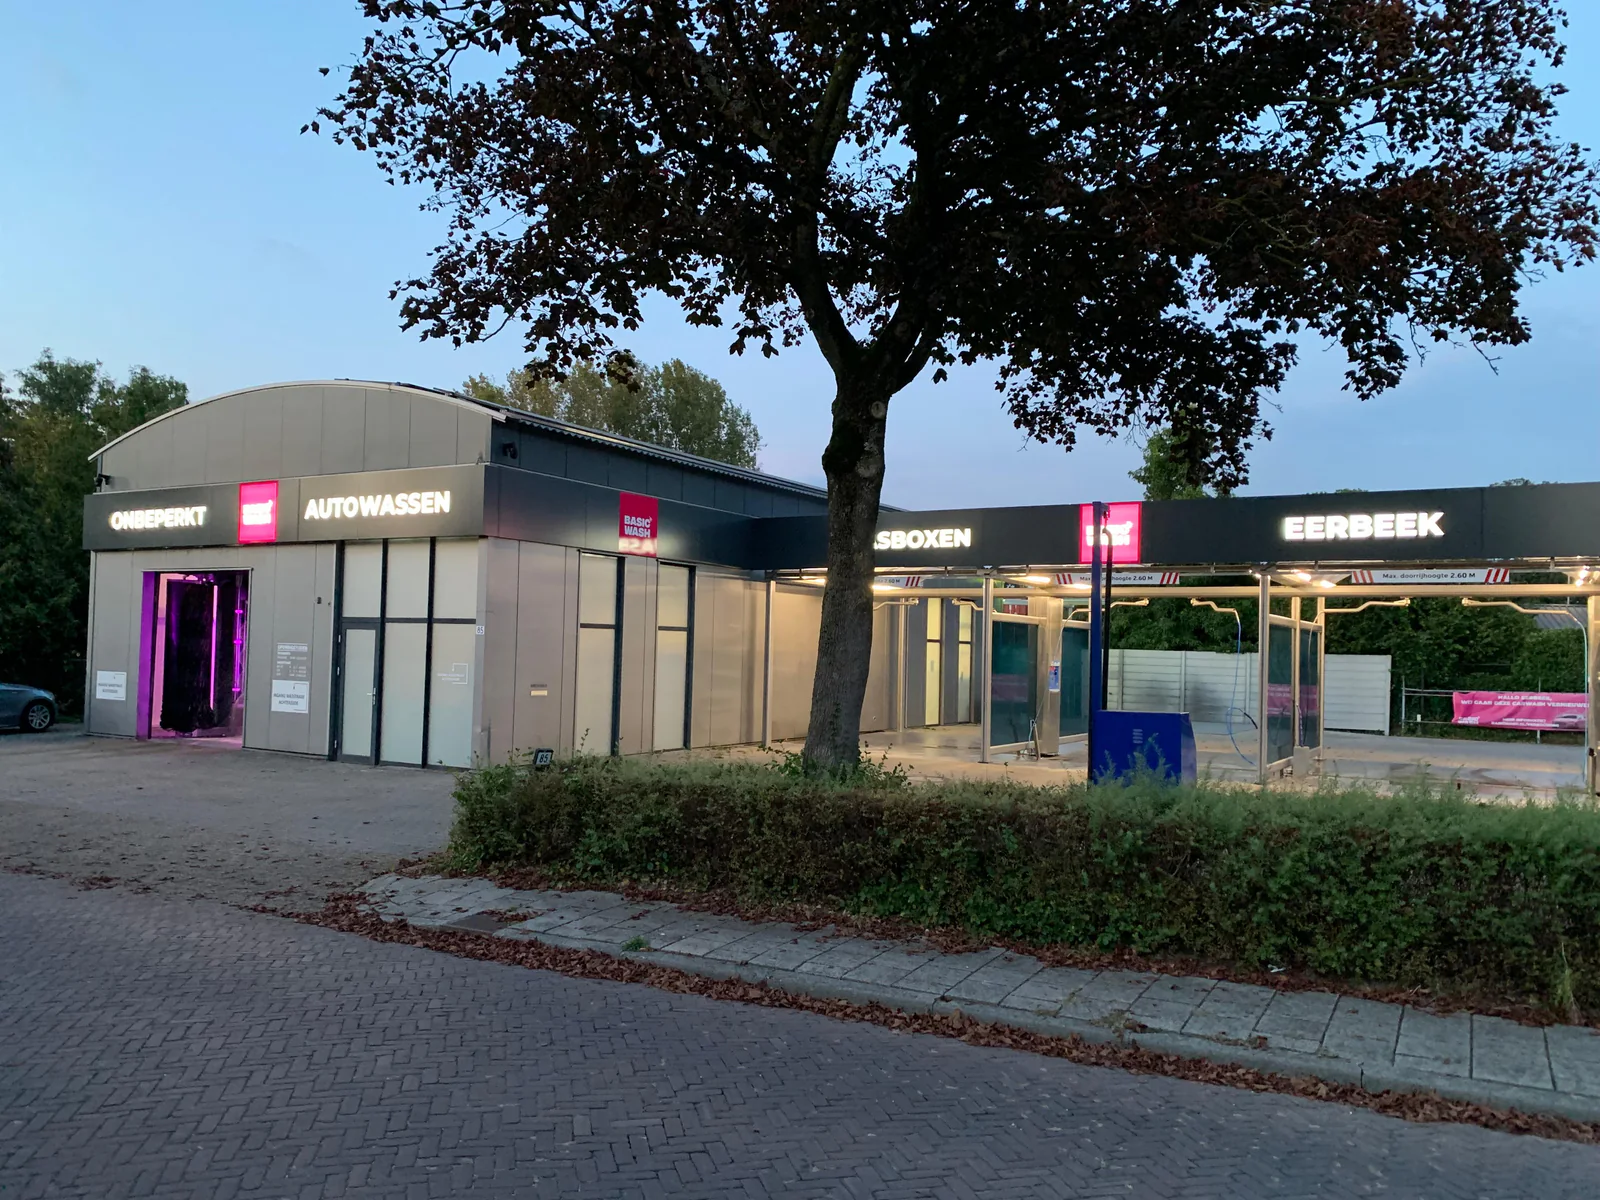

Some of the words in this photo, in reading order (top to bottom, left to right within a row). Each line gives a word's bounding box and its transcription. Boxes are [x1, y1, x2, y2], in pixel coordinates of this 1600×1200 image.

[304, 491, 450, 520] AUTOWASSEN
[110, 506, 207, 530] ONBEPERKT
[624, 515, 651, 528] BASIC
[624, 526, 651, 538] WASH
[1284, 511, 1445, 540] EERBEEK
[1400, 572, 1448, 580] doorrijhoogte
[539, 754, 549, 763] 85
